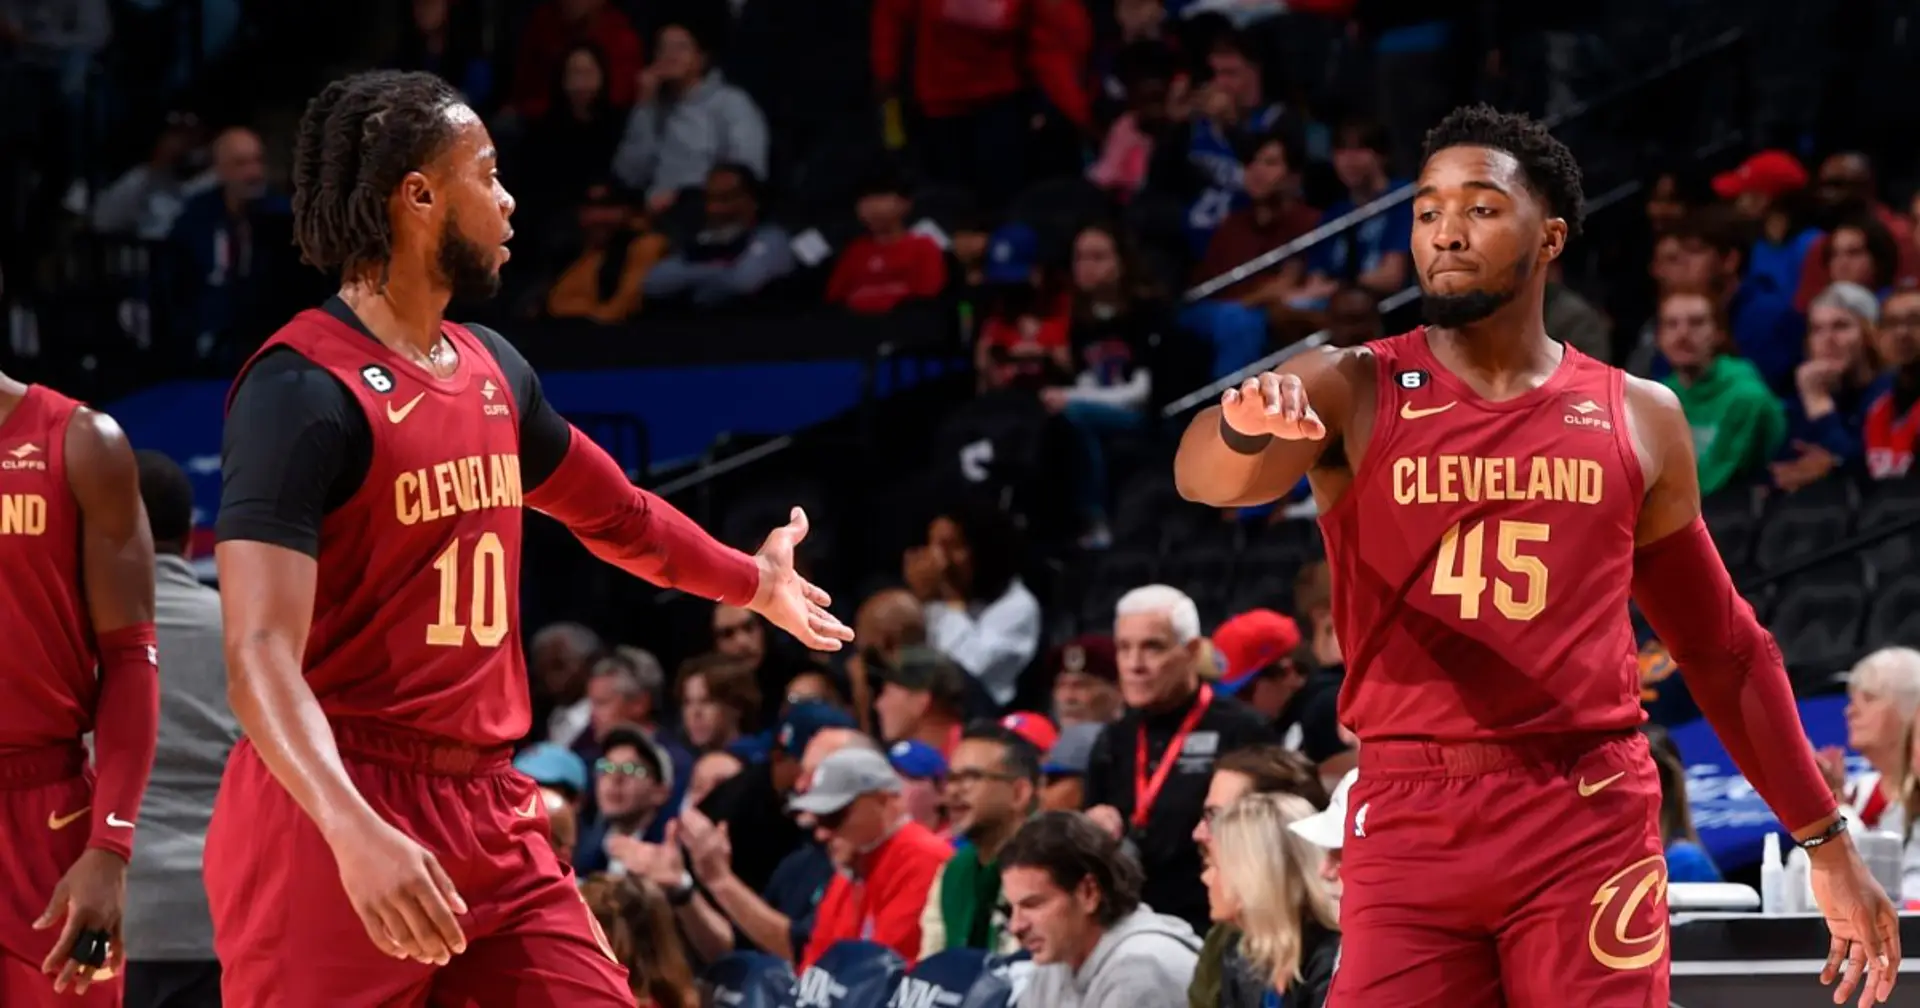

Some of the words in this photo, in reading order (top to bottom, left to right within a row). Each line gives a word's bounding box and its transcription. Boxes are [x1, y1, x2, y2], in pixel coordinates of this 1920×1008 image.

[363, 366, 392, 392] 6
[1402, 372, 1420, 388] 6
[484, 404, 510, 416] CLIFFS
[1564, 414, 1611, 430] CLIFFS
[2, 460, 46, 471] CLIFFS
[1393, 455, 1603, 505] CLEVELAND
[393, 454, 523, 525] CLEVELAN
[0, 494, 47, 536] ND
[426, 532, 508, 647] 10
[1431, 520, 1550, 621] 45
[1589, 854, 1668, 970] C
